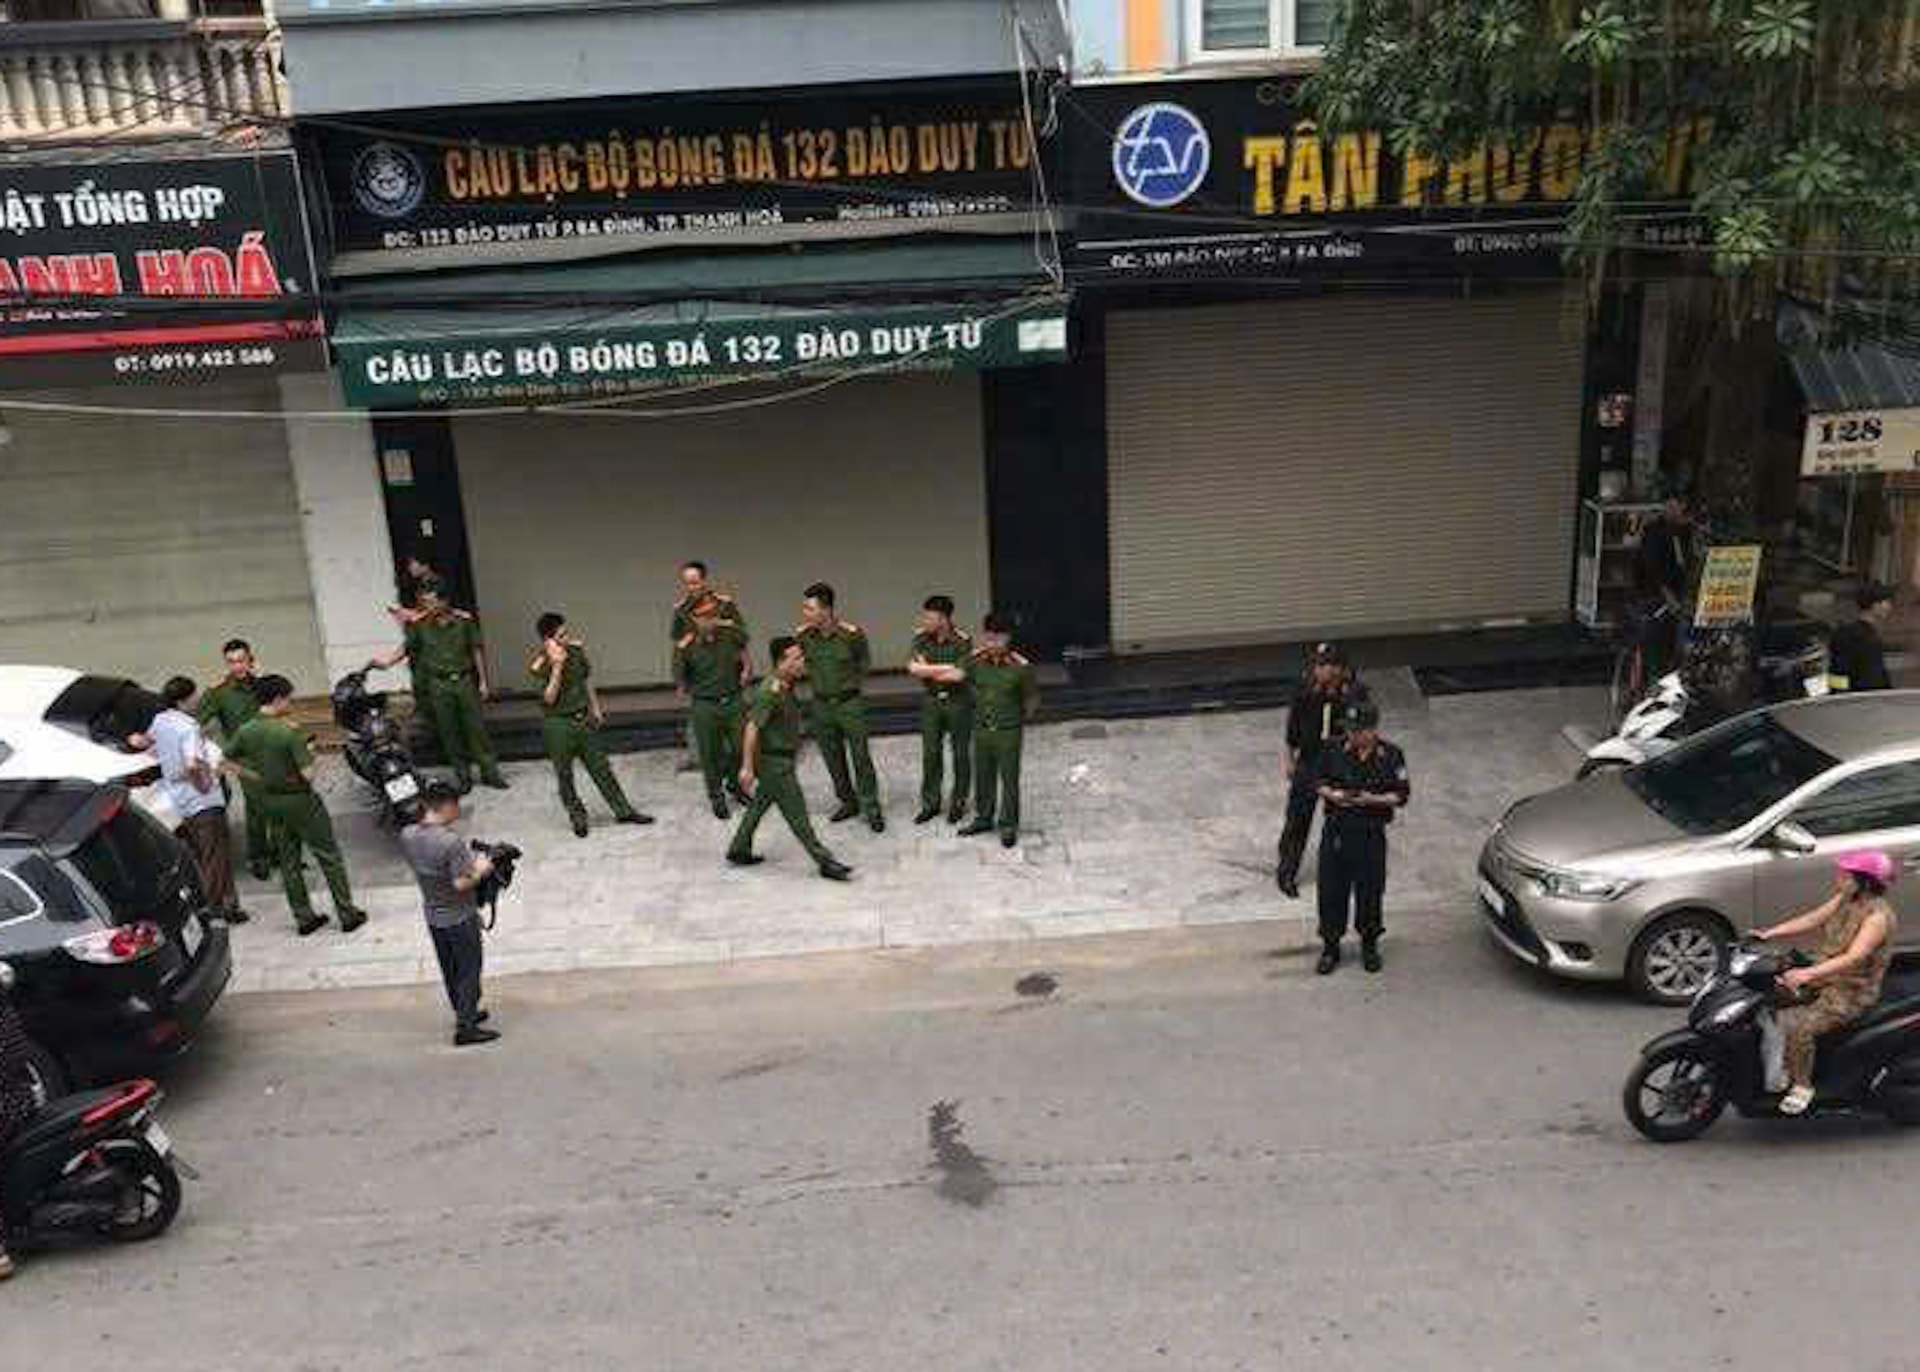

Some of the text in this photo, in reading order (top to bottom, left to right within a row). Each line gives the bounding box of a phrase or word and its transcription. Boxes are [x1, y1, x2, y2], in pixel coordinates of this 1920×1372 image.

[515, 145, 579, 200] LẠC
[587, 129, 632, 199] BỘ
[637, 126, 725, 189] BÓNG
[733, 118, 777, 183] ĐÁ
[784, 128, 839, 180] 132
[846, 114, 910, 177] ĐÀO
[918, 118, 979, 172] DUY
[1244, 119, 1382, 214] TÂN
[0, 179, 225, 236] ẬT TỔNG HỢP
[366, 349, 434, 385] CÂU
[444, 349, 504, 383] LẠC
[515, 341, 560, 378] BỘ
[569, 338, 655, 373] BÓNG
[667, 331, 712, 367] ĐÁ
[723, 334, 783, 364] 132
[796, 325, 860, 361] ĐÀO
[871, 324, 934, 356] DUY
[1820, 417, 1883, 443] 128
